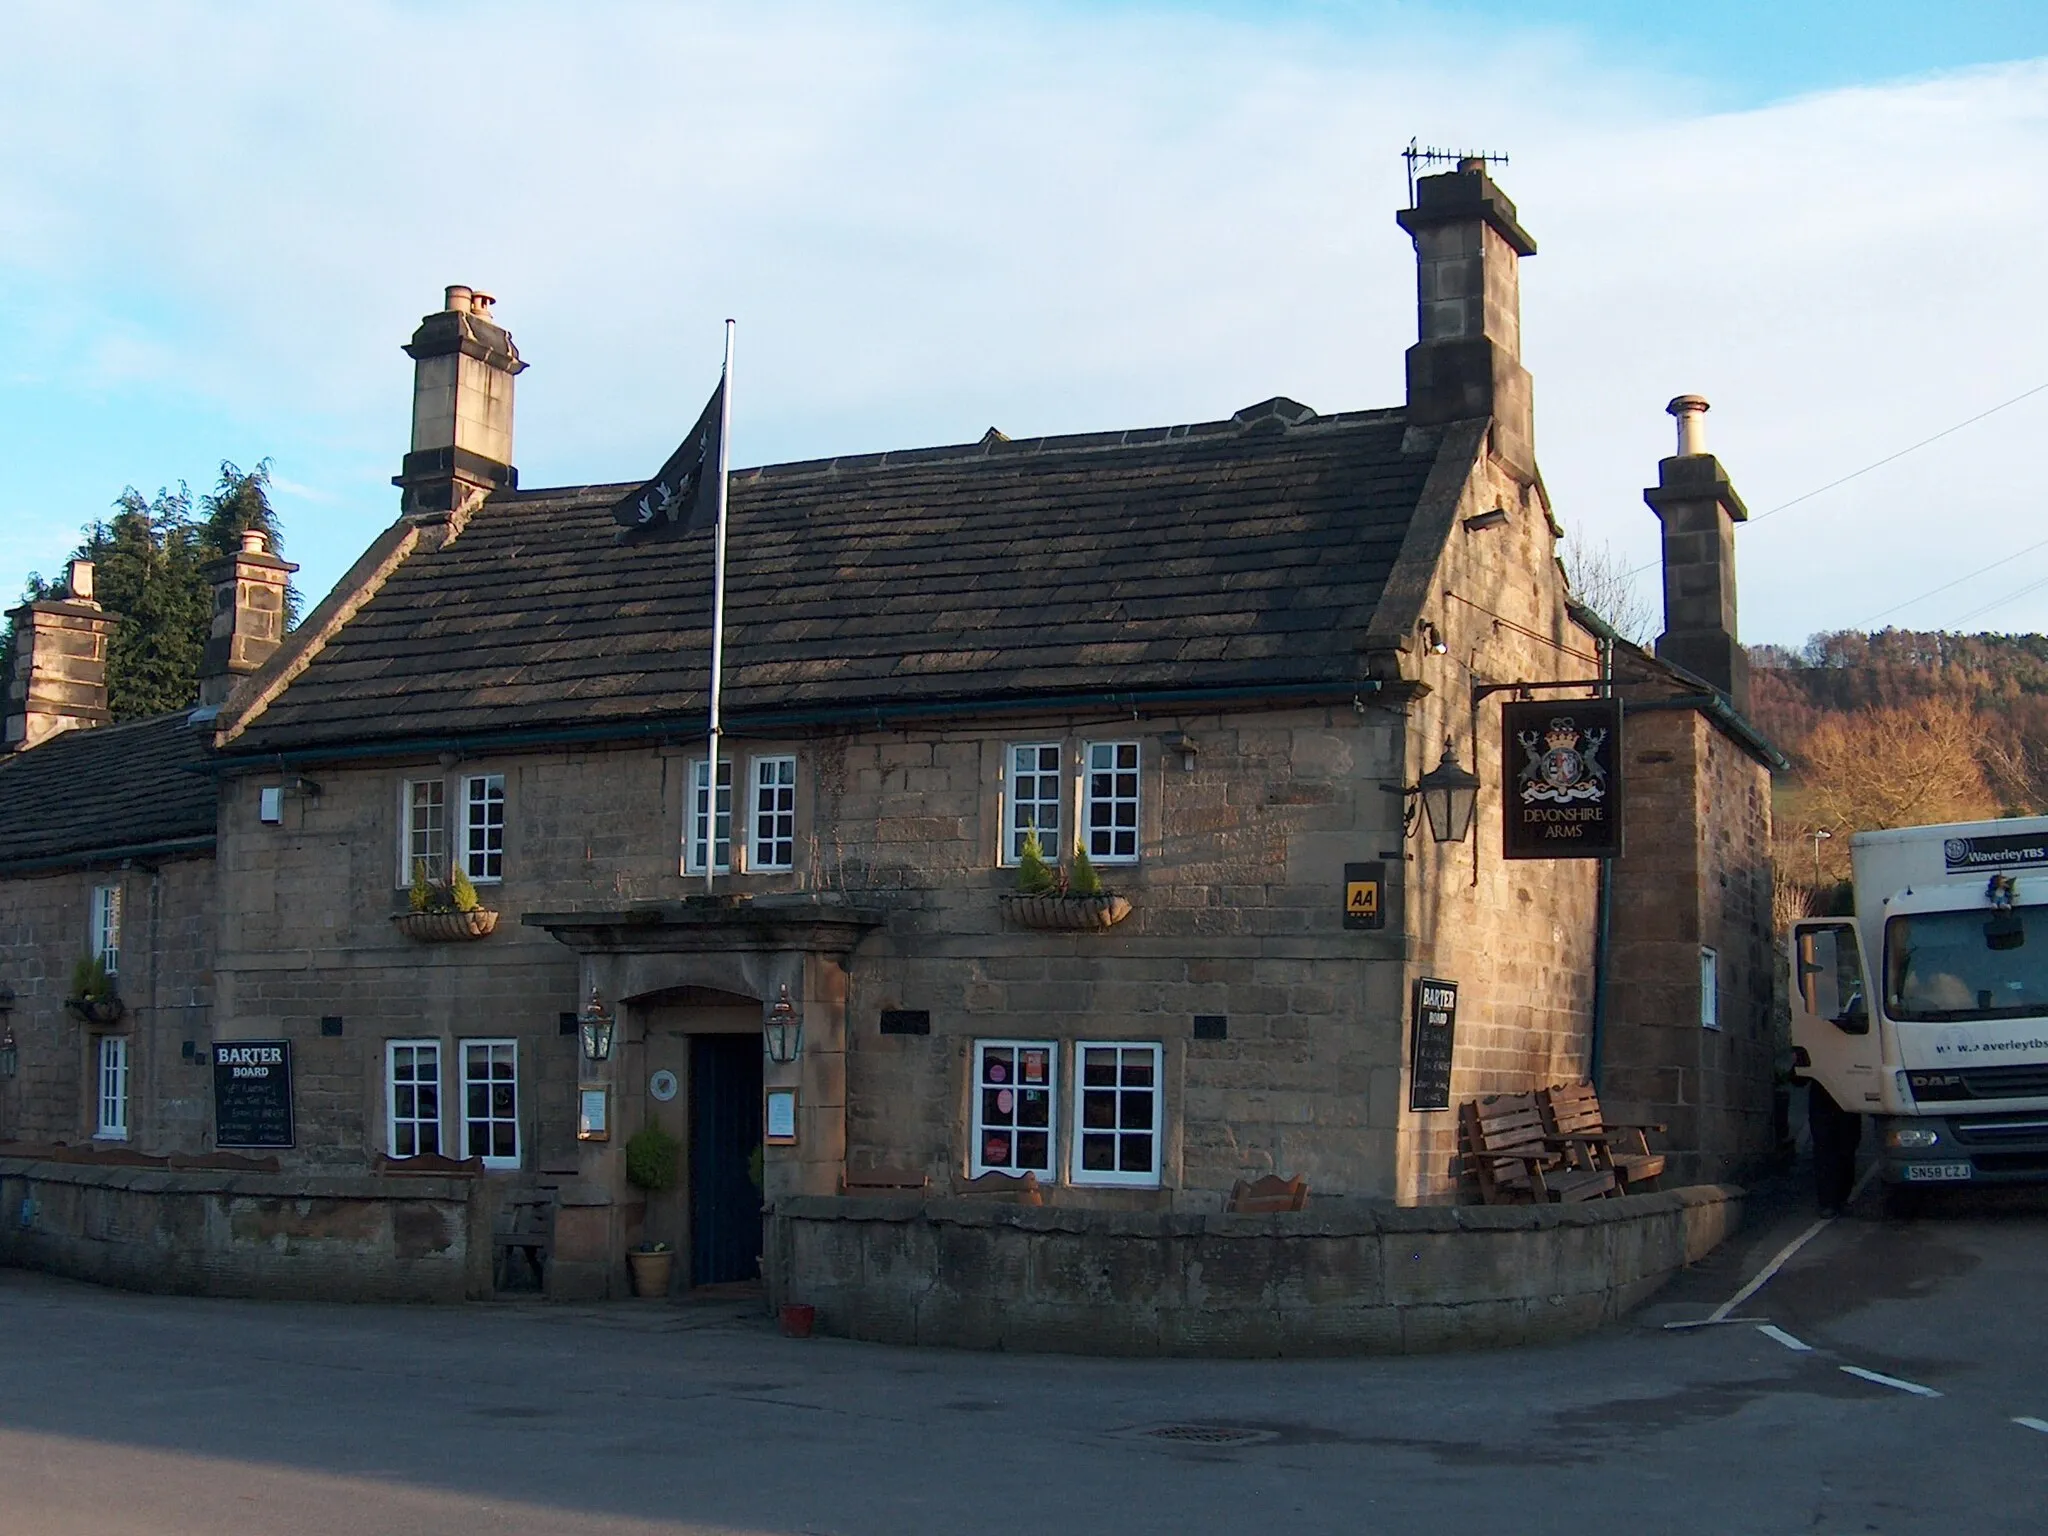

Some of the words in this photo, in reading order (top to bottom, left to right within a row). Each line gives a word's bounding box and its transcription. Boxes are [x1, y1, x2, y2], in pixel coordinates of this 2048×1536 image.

[1524, 807, 1603, 823] DEVONSHIRE
[1544, 824, 1583, 838] ARMS
[1969, 847, 2045, 862] WaverleyTBS
[1351, 890, 1373, 906] AA
[1423, 987, 1455, 1009] BARTER
[1428, 1012, 1448, 1024] BOARD
[217, 1048, 282, 1065] BARTER
[233, 1067, 269, 1077] BOARD
[1912, 1075, 1960, 1087] DAF
[1911, 1167, 1942, 1179] SN58
